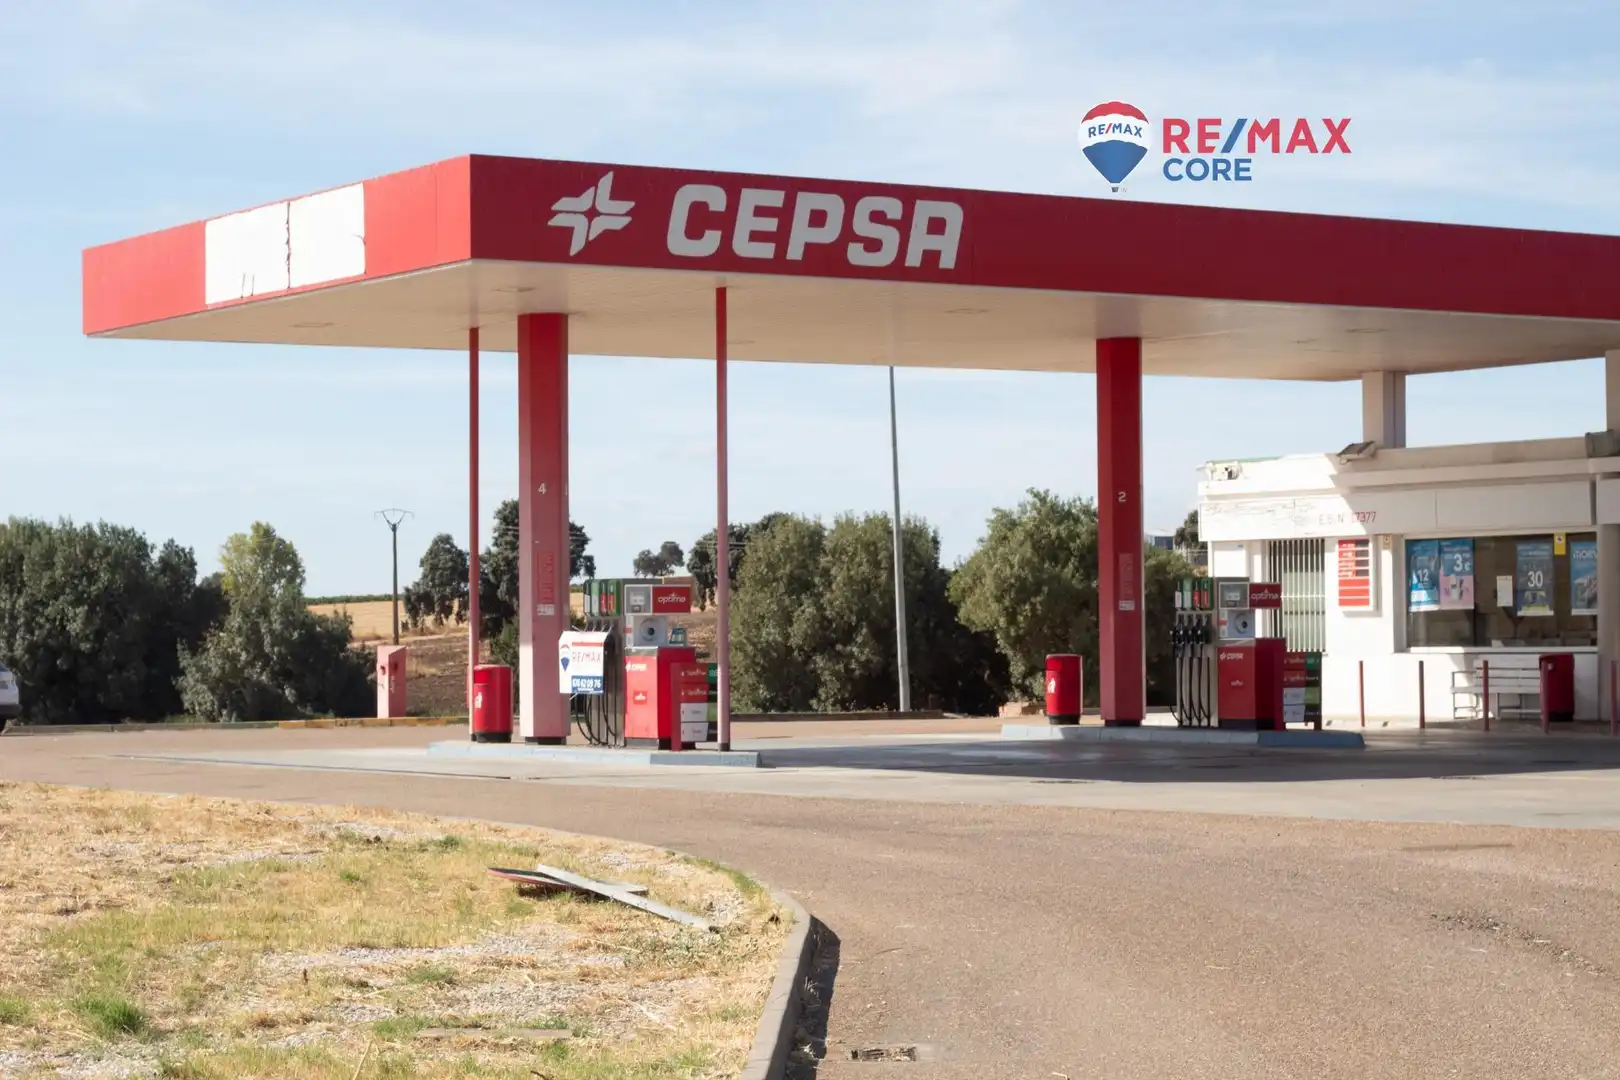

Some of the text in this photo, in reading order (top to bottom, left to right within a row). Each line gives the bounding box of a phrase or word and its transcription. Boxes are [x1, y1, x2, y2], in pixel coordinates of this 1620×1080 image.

[666, 184, 964, 269] CEPSA
[537, 483, 547, 495] 4
[1117, 491, 1127, 503] 2
[1527, 570, 1543, 588] 30
[657, 592, 686, 604] optima
